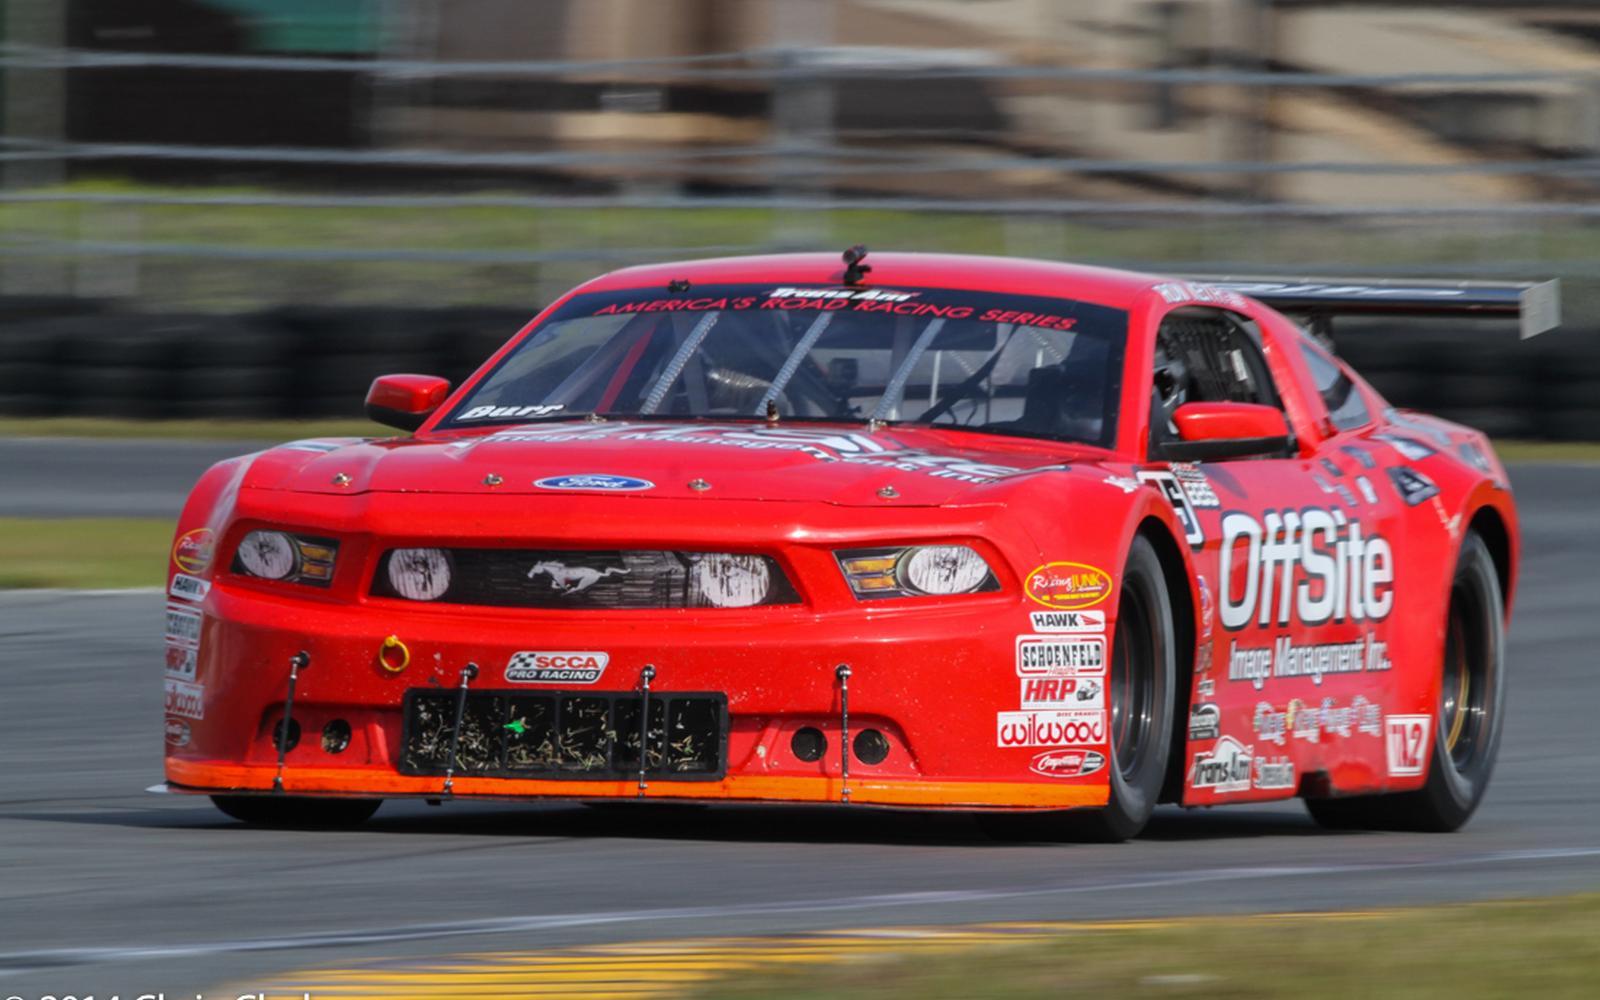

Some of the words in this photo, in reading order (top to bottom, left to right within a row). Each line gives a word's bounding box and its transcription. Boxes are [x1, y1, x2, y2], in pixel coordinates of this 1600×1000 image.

[769, 287, 856, 298] Trans
[851, 289, 911, 302] Am
[592, 296, 756, 316] AMERICA'S
[760, 298, 849, 311] ROAD
[854, 300, 974, 319] RACING
[979, 309, 1077, 330] SERIES
[456, 402, 564, 420] Burr
[558, 475, 627, 489] Ford
[1219, 506, 1393, 632] OffSite
[1033, 613, 1079, 627] HAWK
[535, 655, 600, 669] SCCA
[1023, 643, 1102, 668] SCHOENFELD
[1229, 637, 1272, 691] Image
[1274, 633, 1364, 686] Management
[1366, 630, 1393, 672] Inc.
[508, 670, 537, 679] PRO
[540, 671, 598, 680] RACING
[1024, 679, 1077, 702] HRP
[1001, 713, 1106, 745] wilwood
[1193, 754, 1229, 785] Trans
